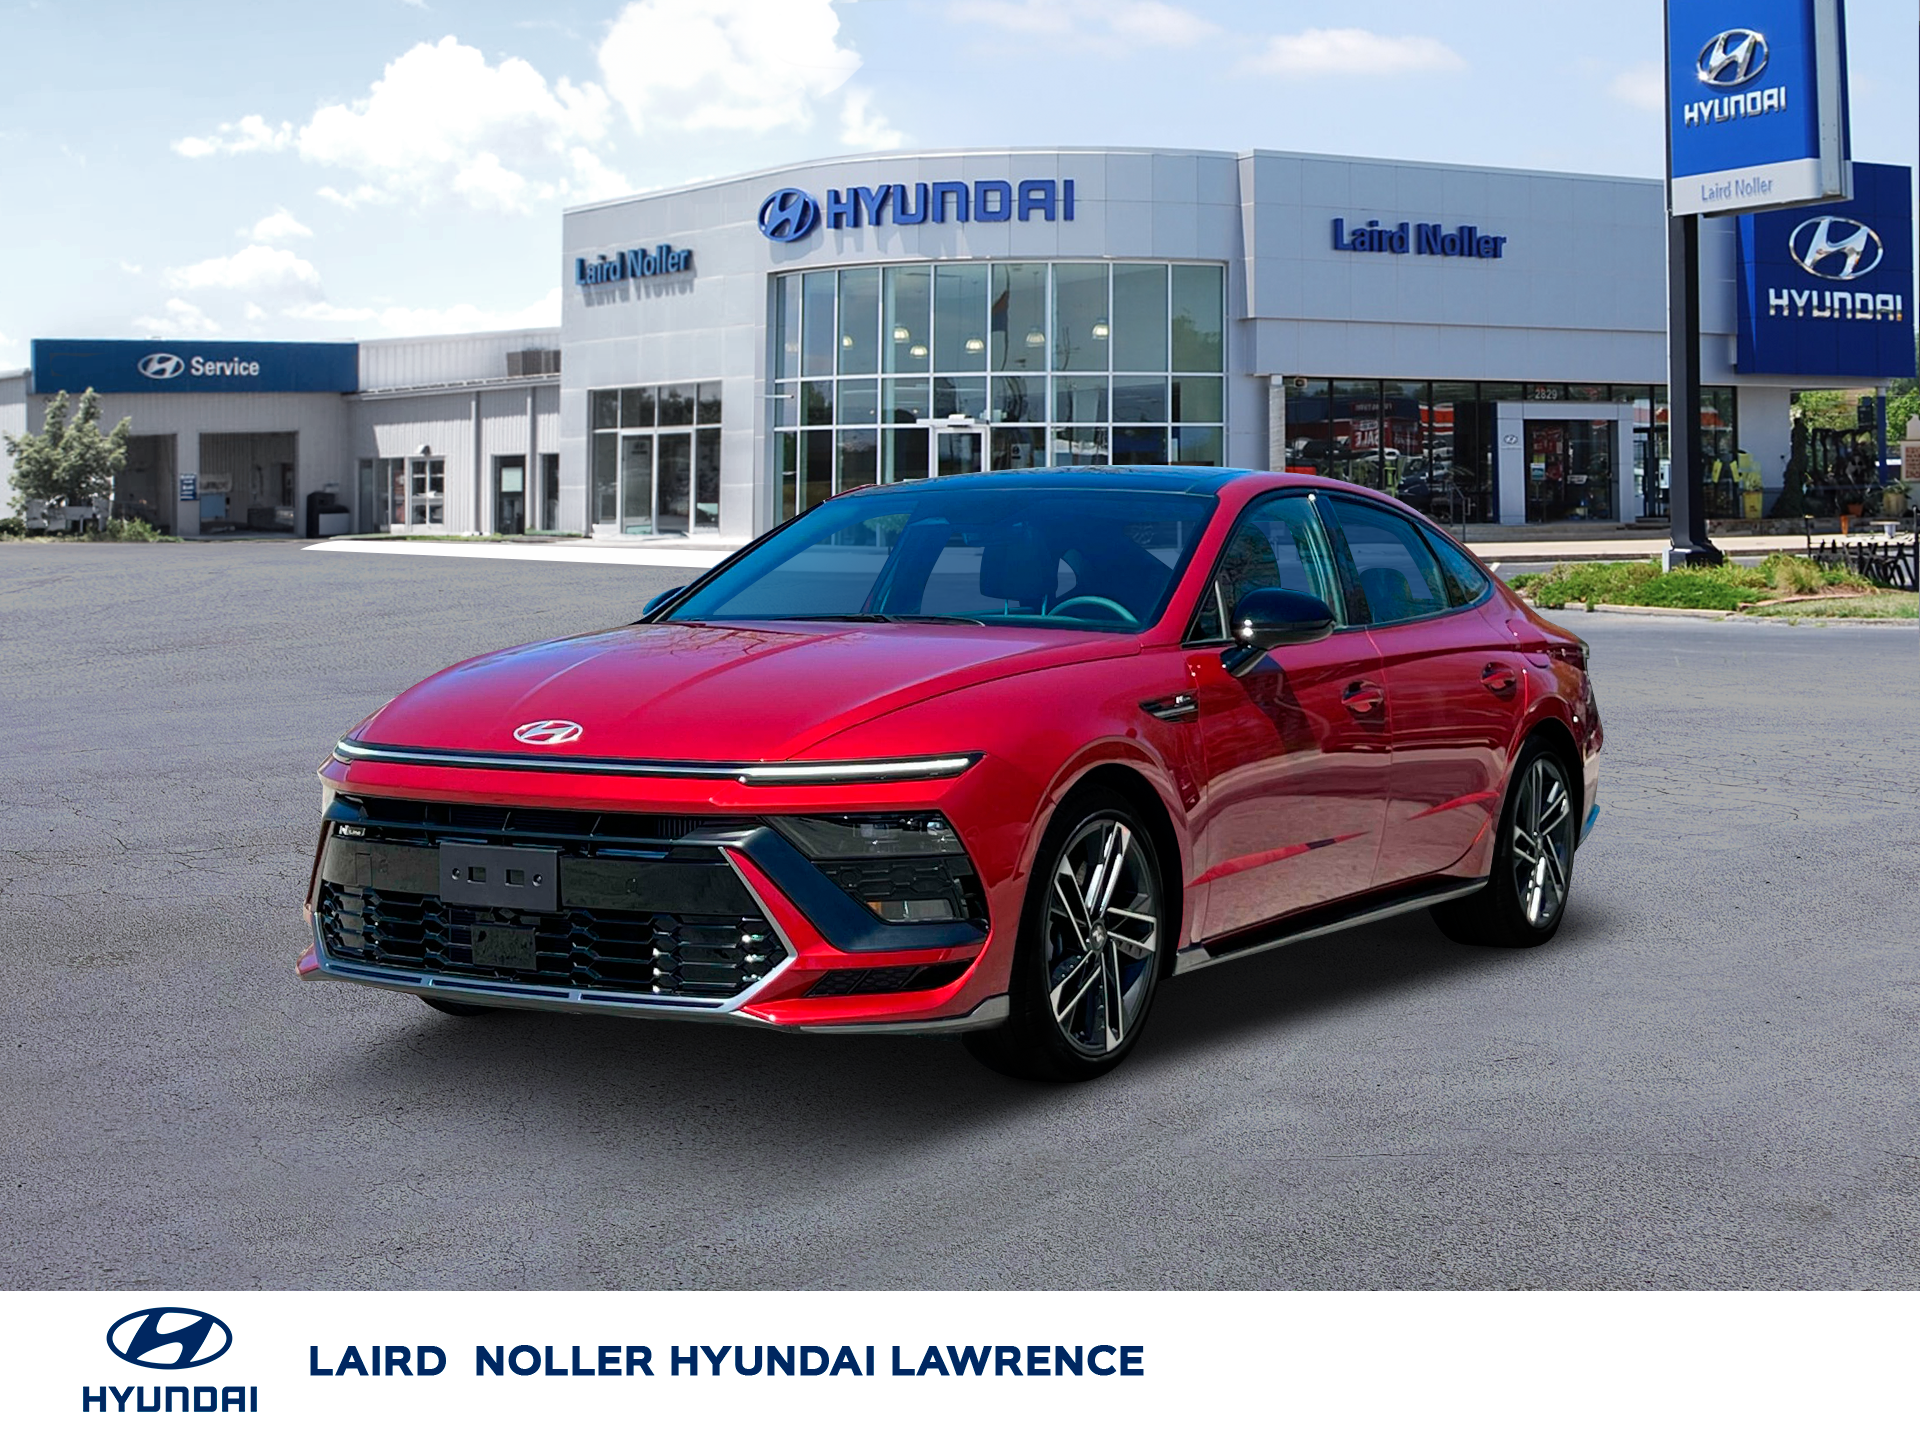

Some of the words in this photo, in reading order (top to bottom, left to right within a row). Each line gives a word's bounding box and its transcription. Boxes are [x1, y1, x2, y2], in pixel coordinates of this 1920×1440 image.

[1684, 86, 1787, 127] HYUNDAI
[826, 178, 1075, 230] HYUNDAI
[1701, 183, 1731, 201] Laird
[1735, 177, 1773, 196] Noller
[1331, 217, 1410, 254] Laird
[1416, 223, 1507, 258] Noller
[575, 257, 626, 285] Laird
[626, 243, 694, 278] Noller
[1769, 288, 1903, 321] HYUNDAI
[190, 356, 260, 376] Service
[1534, 389, 1558, 400] 2829
